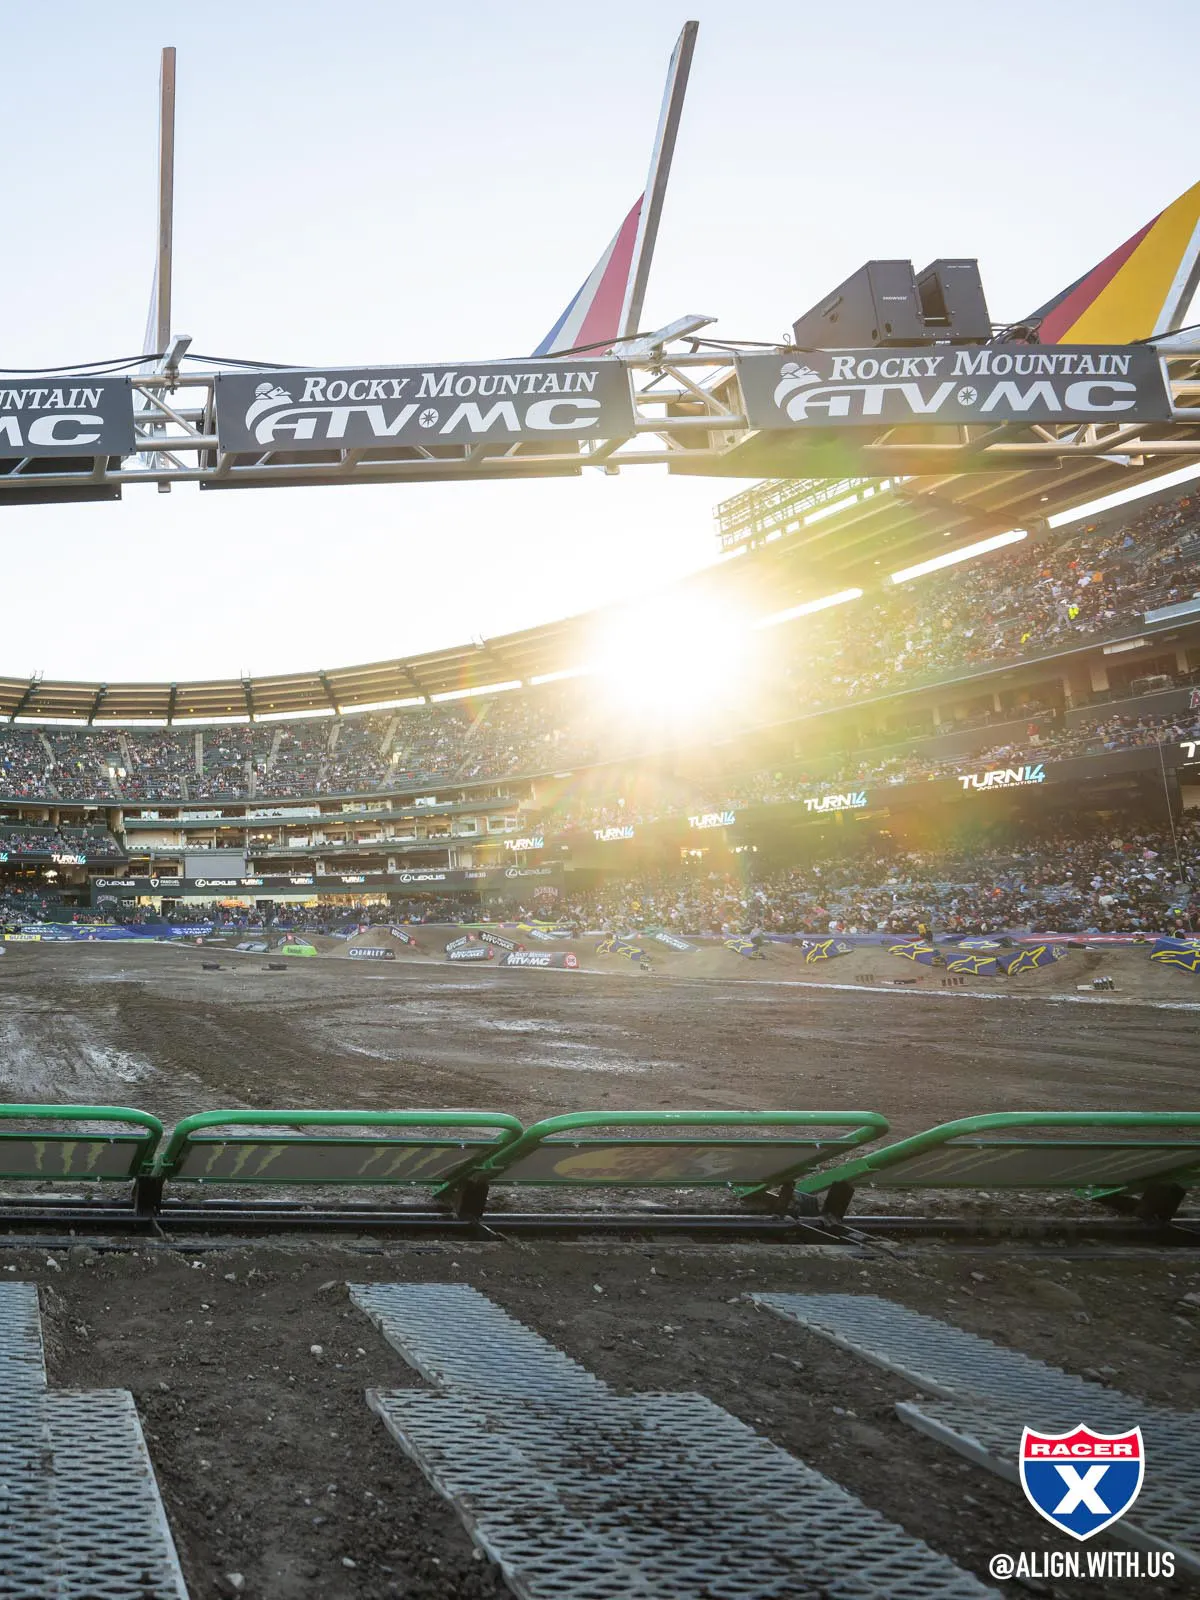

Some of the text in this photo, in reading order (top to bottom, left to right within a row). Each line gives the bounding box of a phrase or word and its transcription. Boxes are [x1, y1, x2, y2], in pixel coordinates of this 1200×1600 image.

[829, 350, 1132, 381] ROCKY MOUNTAIN
[299, 371, 599, 402] ROCKY MOUNTAIN
[787, 380, 1137, 422] ATV MC
[257, 398, 601, 445] ATV MC
[958, 763, 1045, 790] TURN14
[803, 791, 867, 811] TURN14
[593, 825, 634, 840] TURN14
[688, 811, 735, 828] TURN14
[503, 837, 544, 849] TURN14
